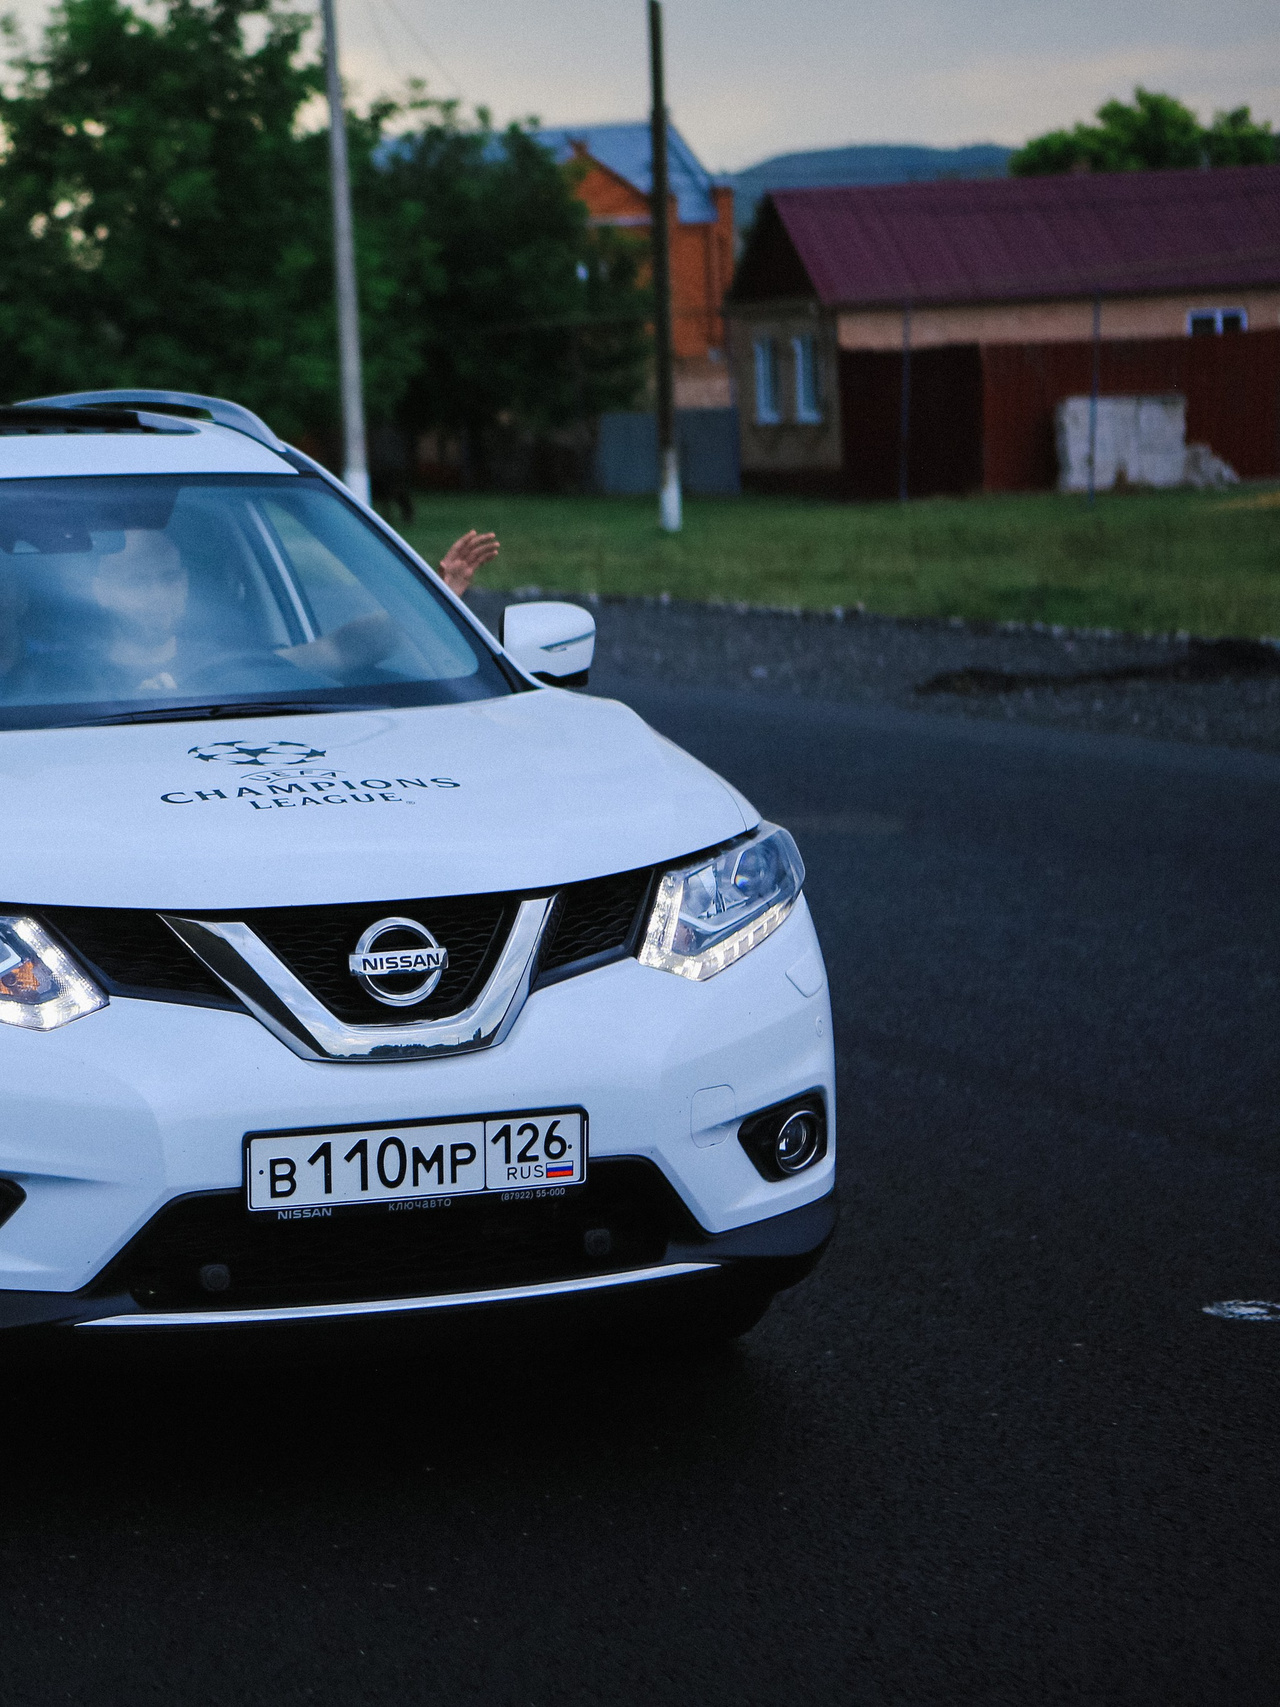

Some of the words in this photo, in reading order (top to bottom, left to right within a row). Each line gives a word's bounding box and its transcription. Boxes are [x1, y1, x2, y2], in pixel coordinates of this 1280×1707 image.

[160, 777, 461, 804] CHAMPIONS
[250, 792, 403, 810] LEAGUE
[362, 953, 440, 971] NISSAN
[490, 1120, 567, 1164] 126
[507, 1164, 544, 1181] RUS
[501, 1190, 534, 1202] (87922)
[535, 1187, 566, 1198] 55-000
[277, 1207, 332, 1220] NISSAN
